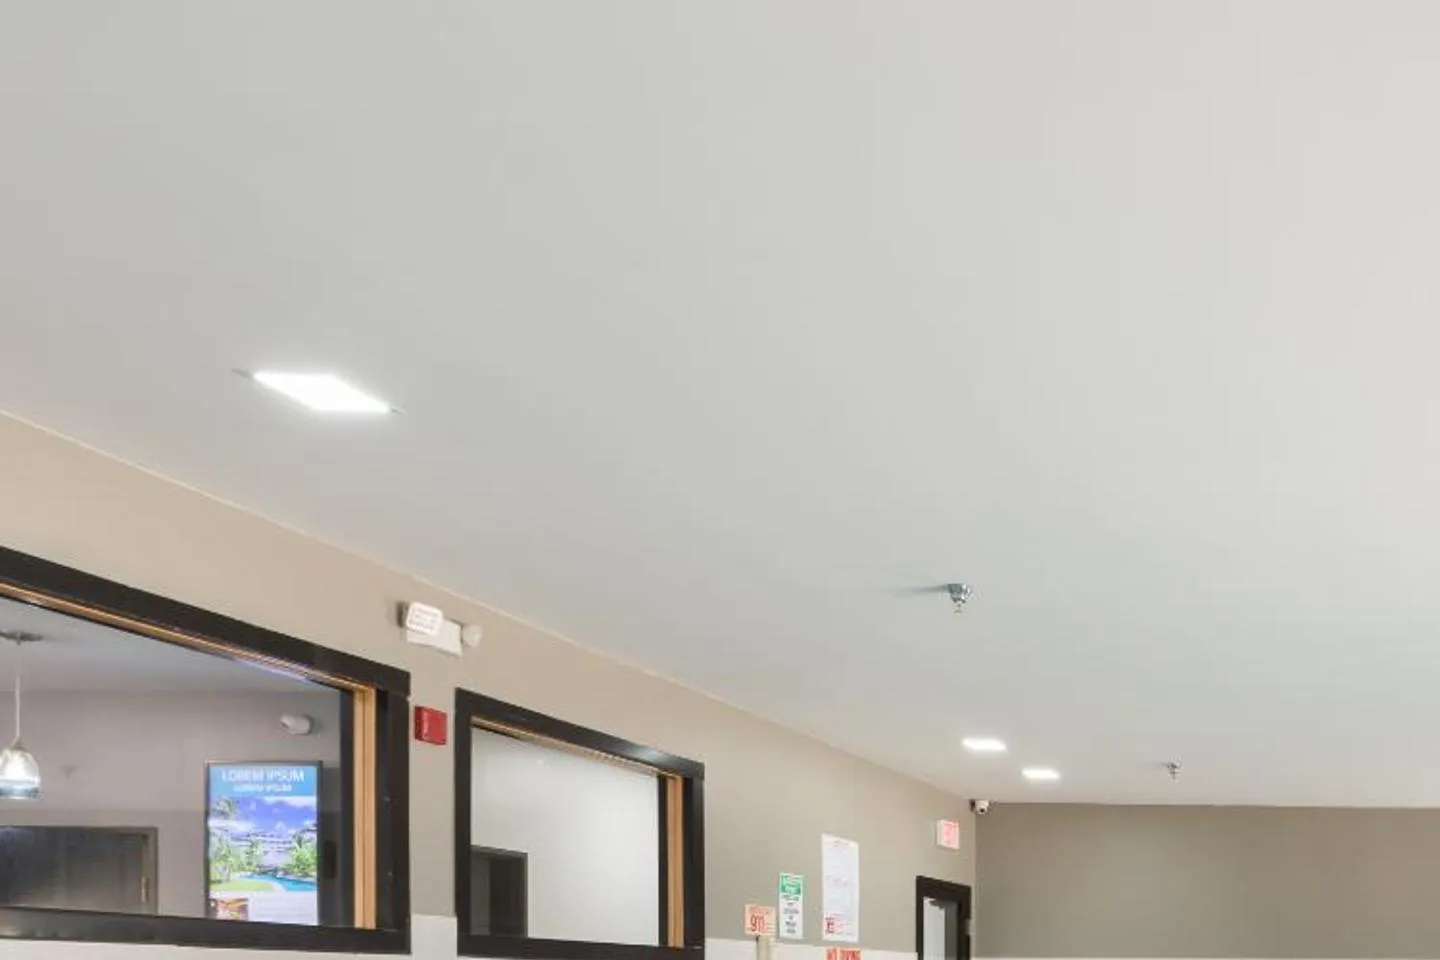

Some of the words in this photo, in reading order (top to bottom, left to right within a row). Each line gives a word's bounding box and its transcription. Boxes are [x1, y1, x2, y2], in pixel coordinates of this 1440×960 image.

[221, 768, 264, 781] LOREM
[266, 768, 304, 782] IPSUM
[750, 914, 765, 933] 911
